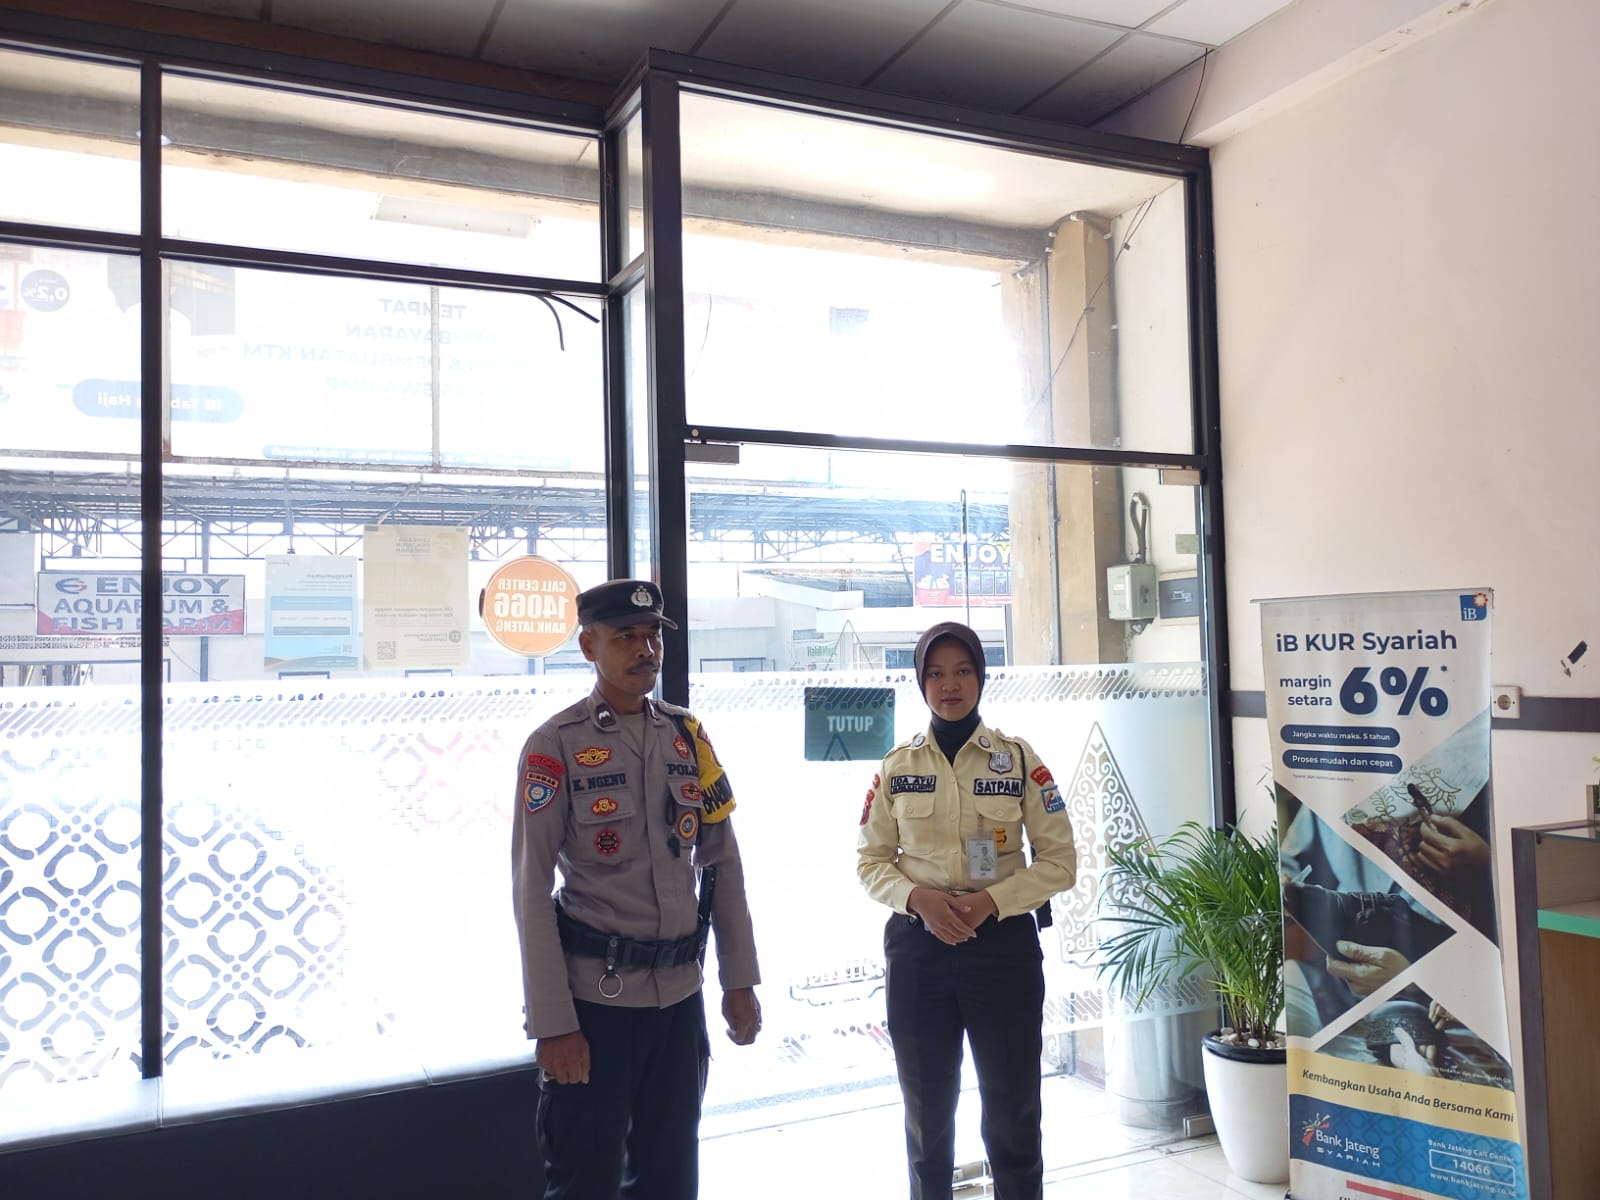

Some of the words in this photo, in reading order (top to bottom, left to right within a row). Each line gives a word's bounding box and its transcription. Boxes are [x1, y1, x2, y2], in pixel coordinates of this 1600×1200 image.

[930, 542, 1011, 563] ENJOY
[96, 577, 231, 594] ENJOY
[54, 597, 202, 614] AQUAUM
[210, 598, 231, 613] &
[1463, 607, 1478, 620] iB
[52, 616, 124, 631] FISH
[136, 617, 232, 632] ARM
[1275, 633, 1299, 652] iB
[1305, 632, 1355, 651] KUR
[1362, 629, 1458, 655] Syariah
[1279, 674, 1332, 690] margin
[1287, 694, 1333, 706] setara
[826, 715, 874, 733] TUTUP
[1291, 730, 1317, 740] Jangka
[1318, 731, 1338, 740] waktu
[1339, 732, 1363, 741] maks.
[1363, 733, 1368, 741] 5
[1369, 733, 1391, 742] tahun
[666, 763, 698, 777] POLR
[1291, 755, 1319, 765] Proses
[1319, 756, 1348, 766] mudah
[1349, 757, 1369, 767] dan
[1369, 759, 1394, 770] cepat
[976, 779, 1021, 795] SATPAM
[1301, 1069, 1366, 1093] Kembangkan
[1367, 1084, 1402, 1099] Usaha
[1403, 1090, 1431, 1106] Anda
[1433, 1098, 1482, 1117] Bersama
[1484, 1107, 1514, 1123] Kami
[1315, 1129, 1342, 1148] Bank
[1343, 1136, 1380, 1159] Jateng
[1427, 1138, 1446, 1149] Bank
[1447, 1142, 1472, 1156] Jateng
[1473, 1147, 1488, 1158] Call
[1489, 1151, 1514, 1163] Center
[1317, 1146, 1381, 1168] SYARIAH
[1452, 1158, 1491, 1176] 14066
